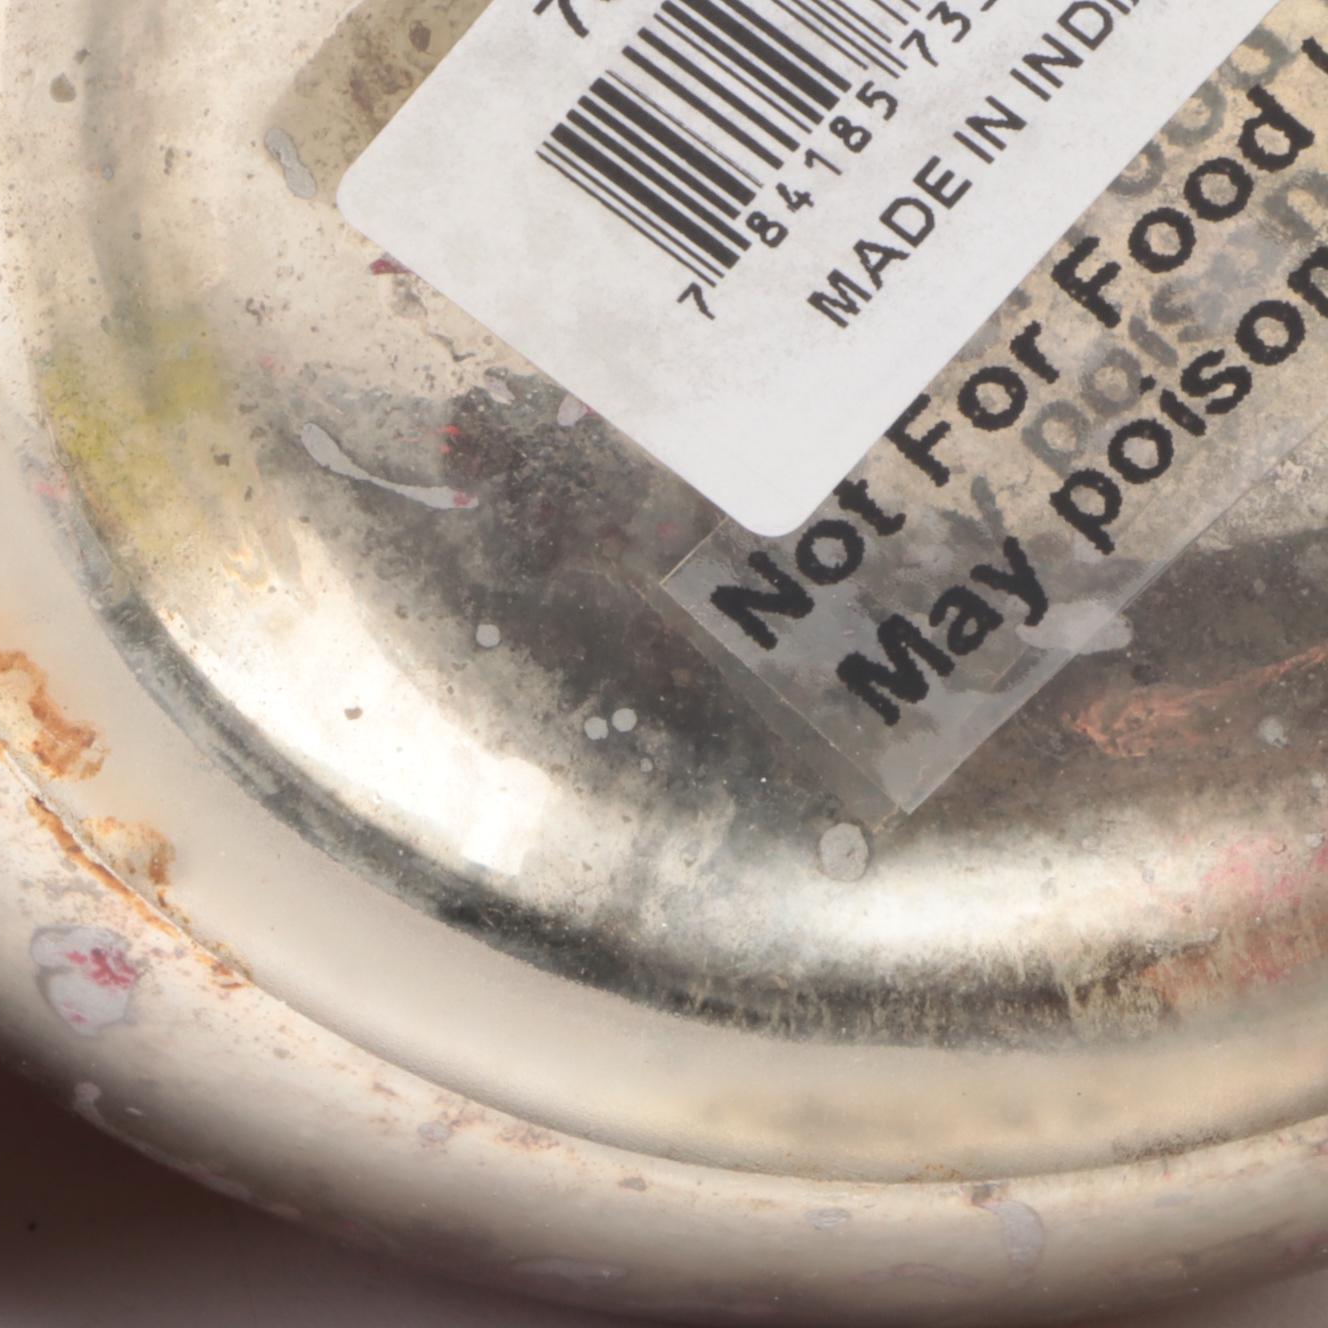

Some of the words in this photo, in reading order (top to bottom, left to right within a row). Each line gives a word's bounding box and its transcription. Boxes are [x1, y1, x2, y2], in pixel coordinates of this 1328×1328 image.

[677, 282, 715, 320] 7
[745, 80, 898, 248] 84185
[807, 155, 972, 328] MADE
[953, 95, 1027, 164] IN
[709, 479, 908, 652] Not
[886, 320, 1061, 487] For
[1052, 84, 1316, 328] Food
[836, 536, 1050, 727] May
